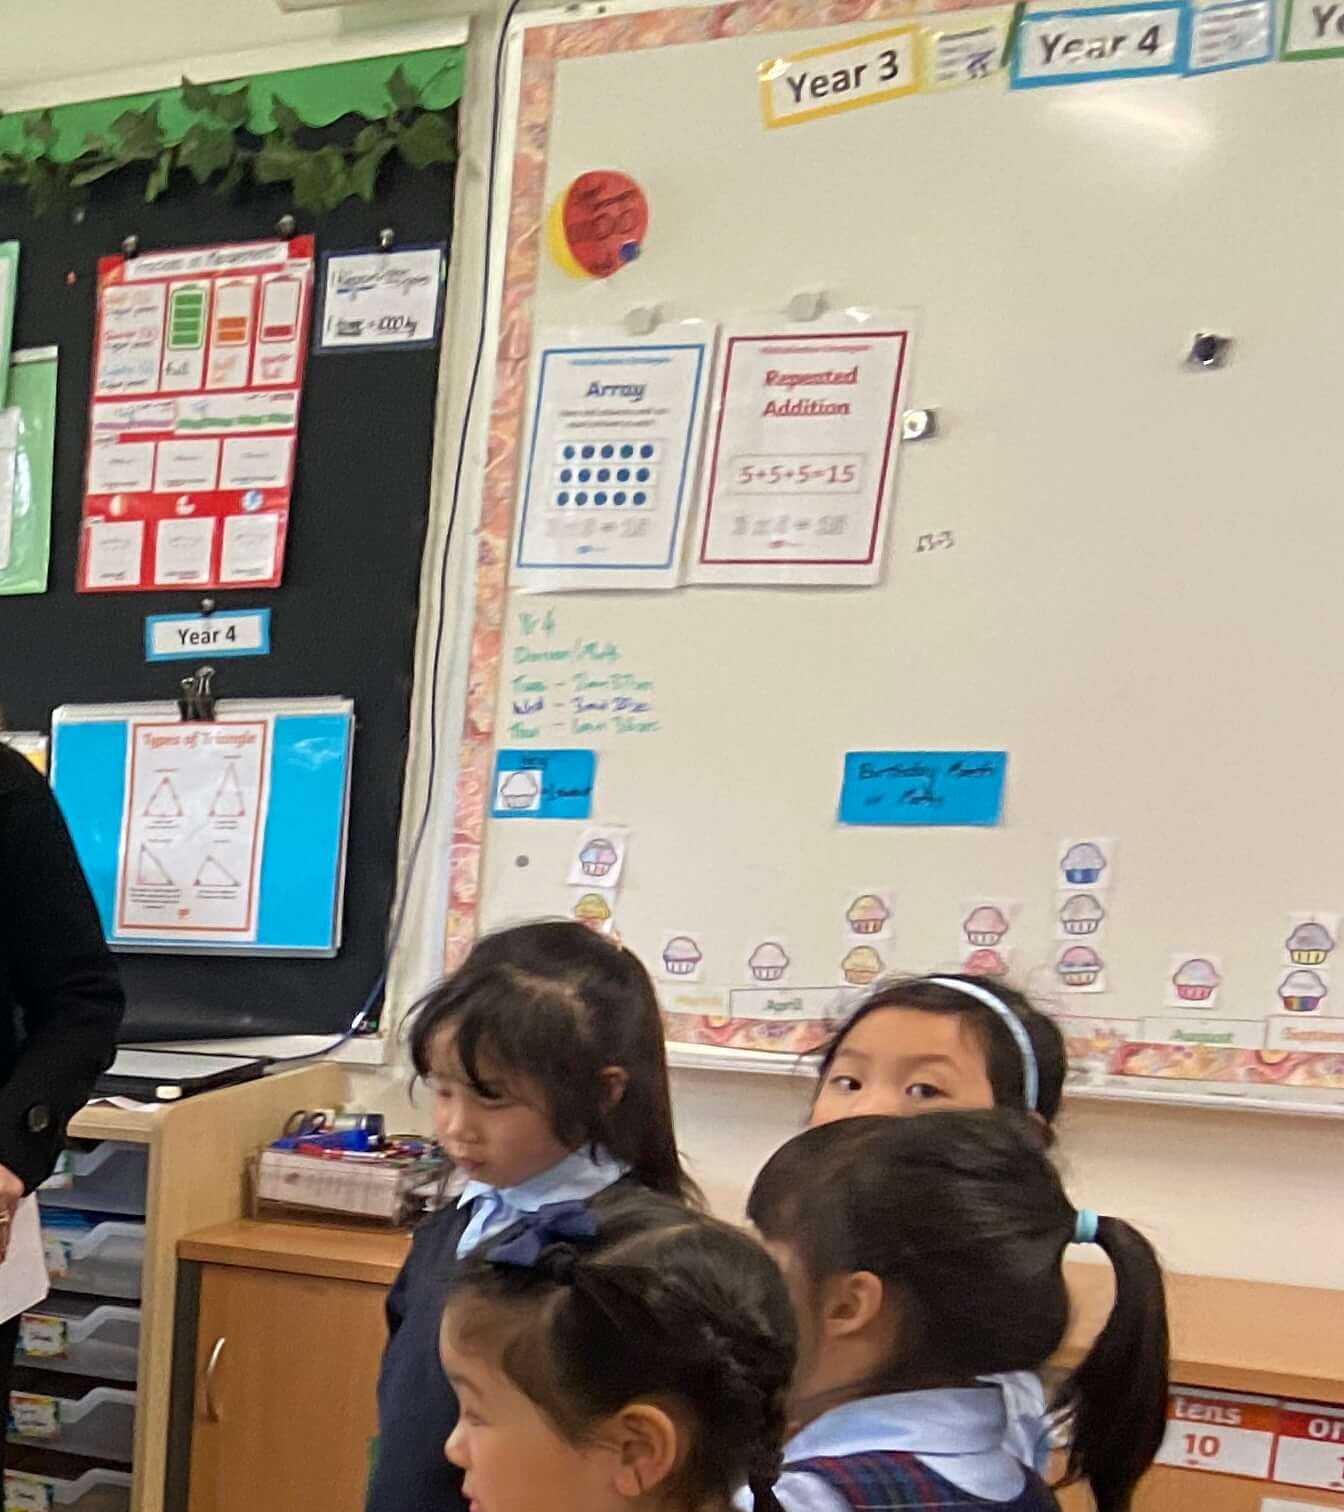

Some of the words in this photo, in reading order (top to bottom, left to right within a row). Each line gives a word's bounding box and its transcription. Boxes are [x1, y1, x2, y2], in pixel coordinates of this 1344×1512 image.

[1038, 31, 1127, 66] Year
[1137, 24, 1160, 54] 4
[786, 63, 866, 103] Year
[877, 50, 899, 82] 3
[765, 366, 859, 388] Repeated
[585, 380, 646, 401] Array
[762, 400, 850, 418] Addition
[178, 627, 219, 645] Year
[226, 625, 237, 642] 4
[1175, 1396, 1242, 1425] tens
[1184, 1433, 1221, 1458] 10
